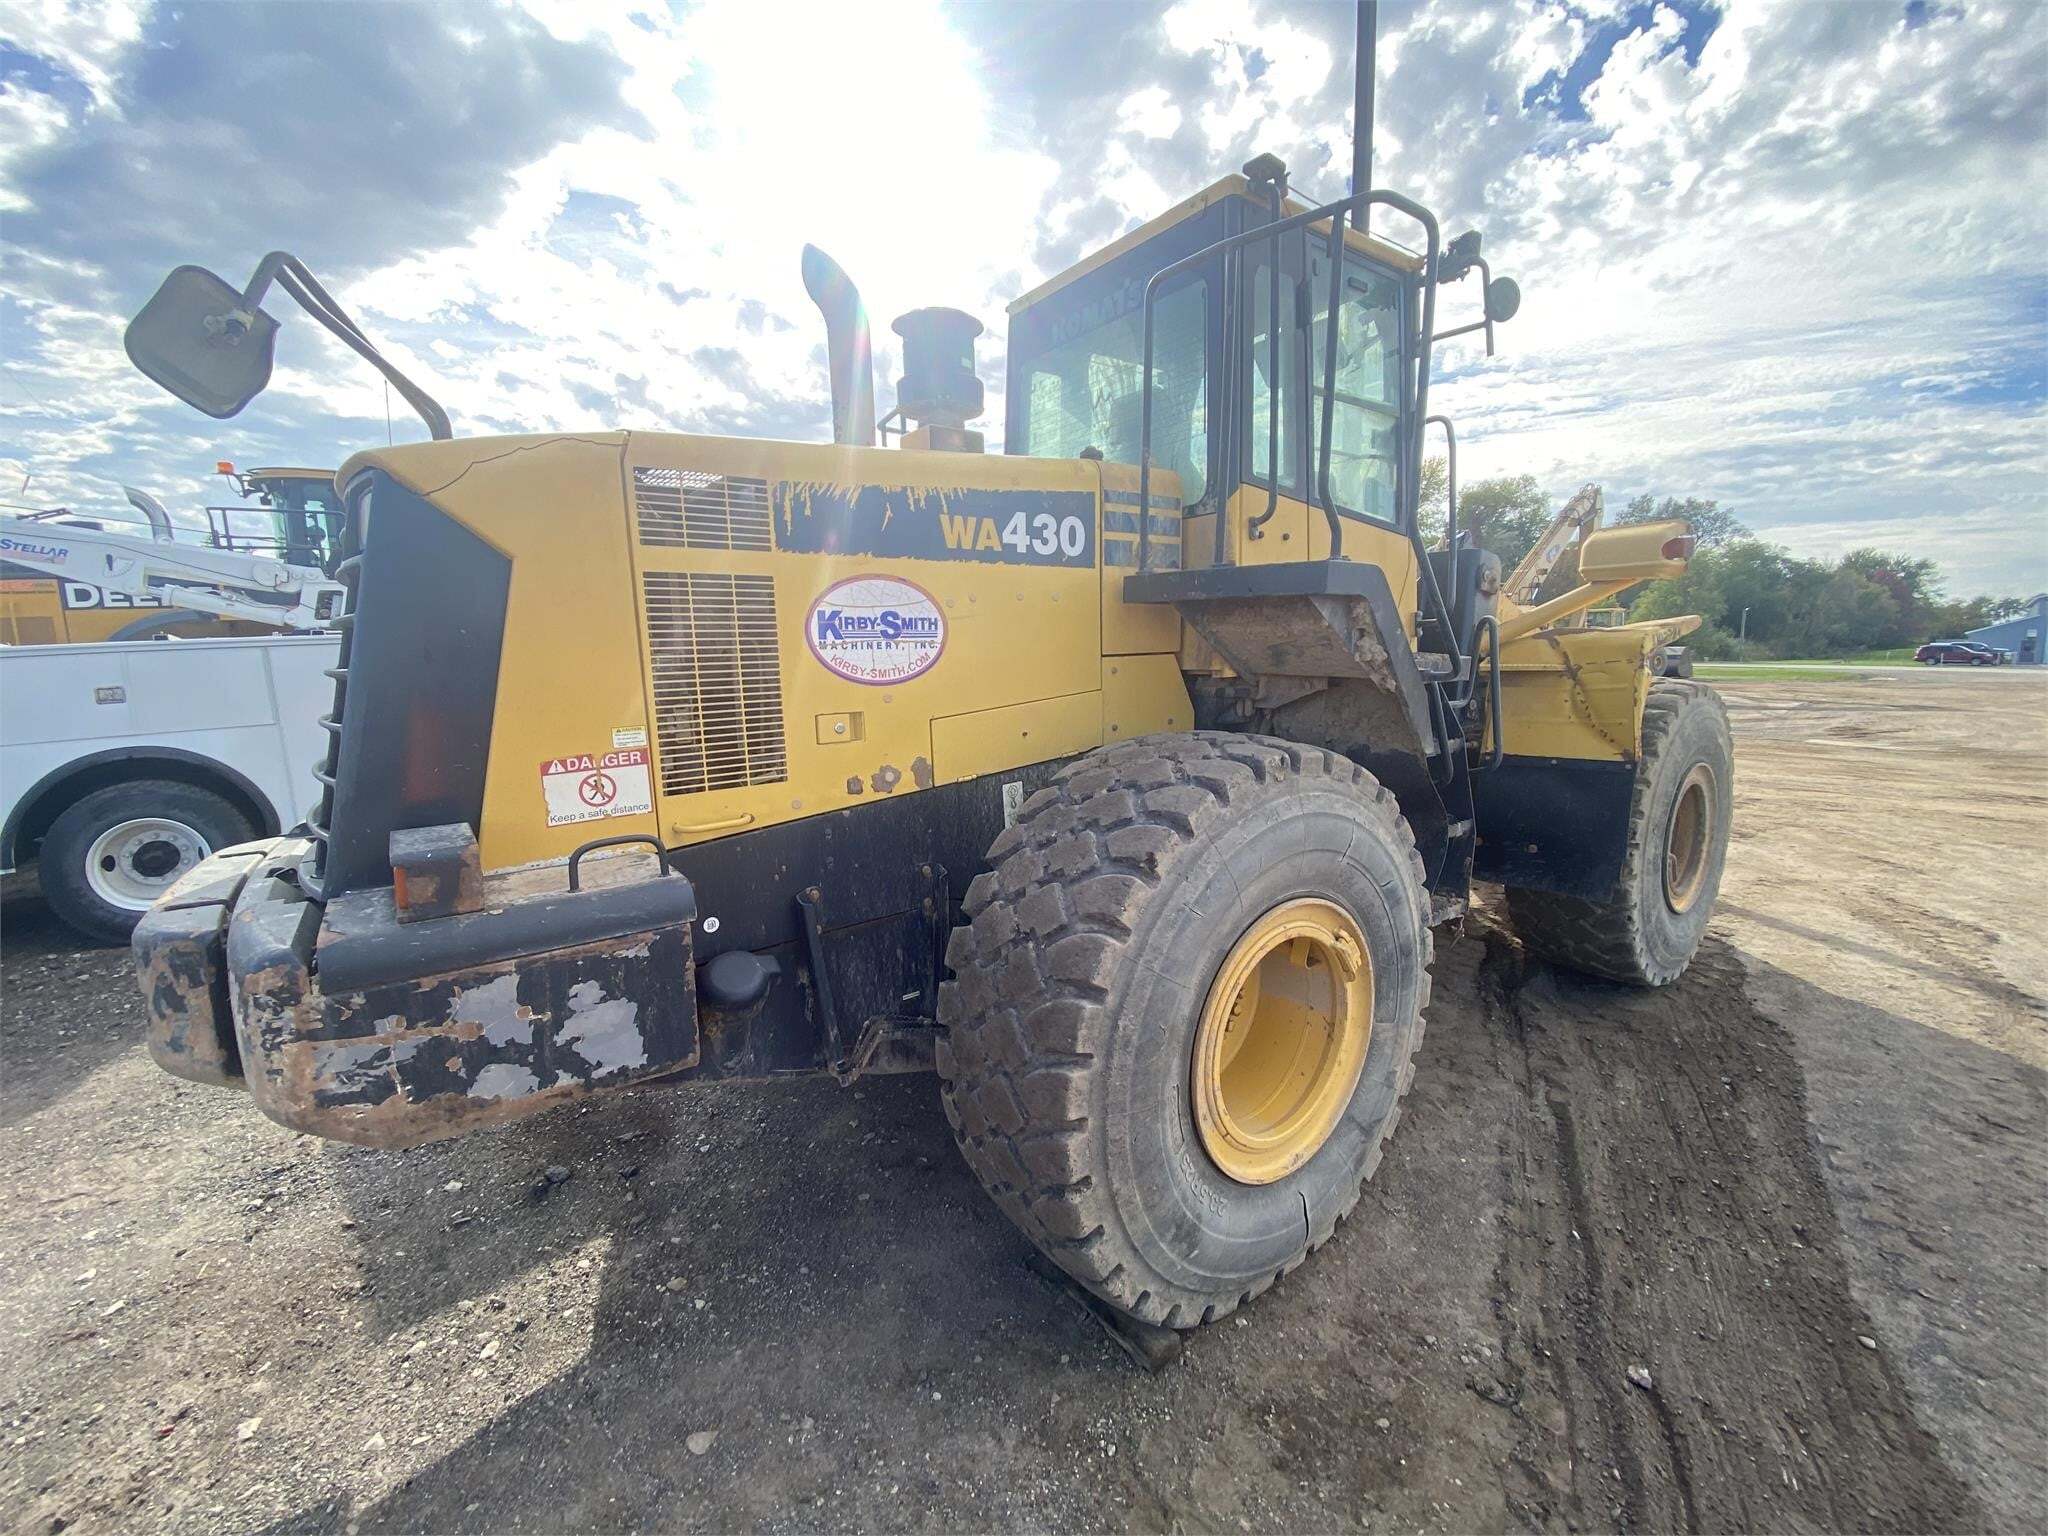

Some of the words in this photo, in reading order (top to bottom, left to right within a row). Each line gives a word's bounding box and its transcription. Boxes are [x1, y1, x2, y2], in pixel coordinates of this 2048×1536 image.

[1050, 277, 1147, 345] KOMATS
[0, 538, 69, 557] STELLAR
[939, 511, 1086, 557] WA430
[816, 609, 939, 640] KIRBY-SMITH
[818, 640, 905, 651] MACHINERY,
[914, 640, 938, 650] INC.
[830, 652, 931, 679] KIRBY-SMITH.COM
[550, 814, 577, 825] Keep
[588, 807, 608, 818] safe
[610, 803, 650, 815] distance
